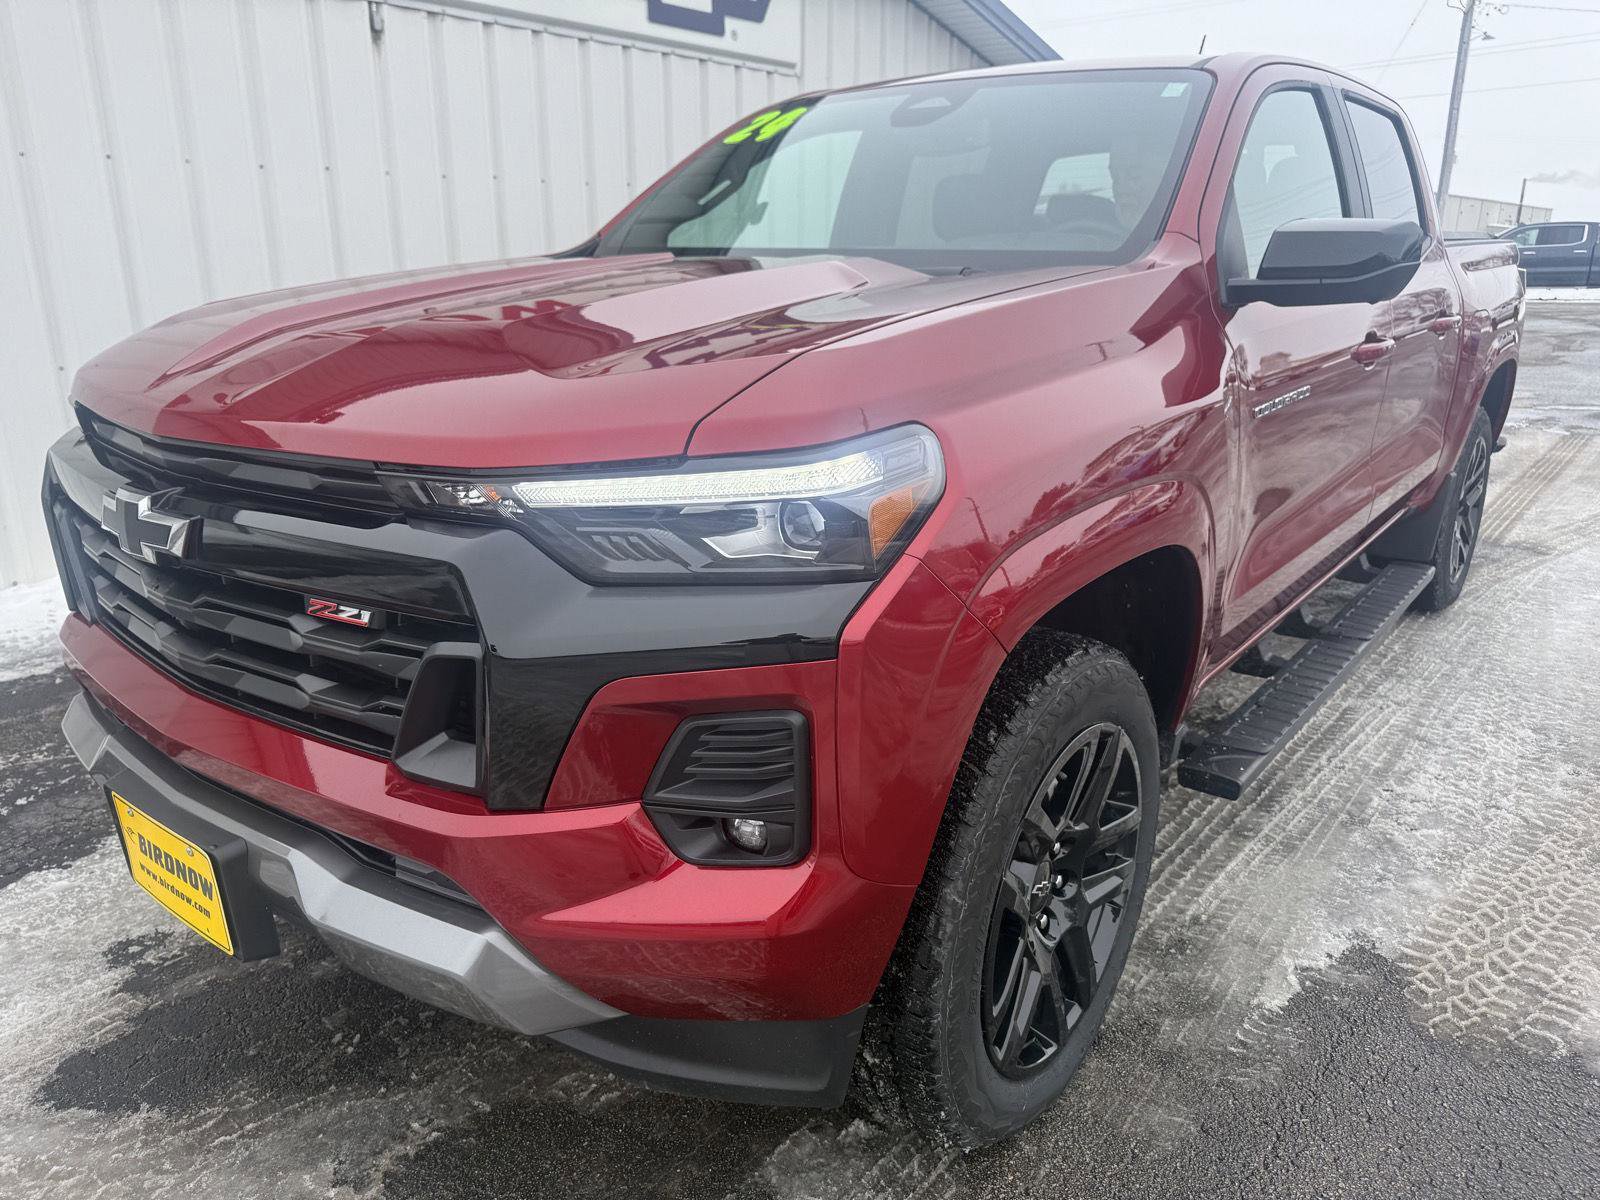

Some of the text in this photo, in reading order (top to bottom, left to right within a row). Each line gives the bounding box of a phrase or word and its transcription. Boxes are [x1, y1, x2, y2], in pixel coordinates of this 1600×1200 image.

[723, 107, 808, 144] 24
[306, 598, 371, 628] Z71
[137, 832, 213, 901] BIRDNOW
[140, 861, 210, 919] www.birdnow.com
